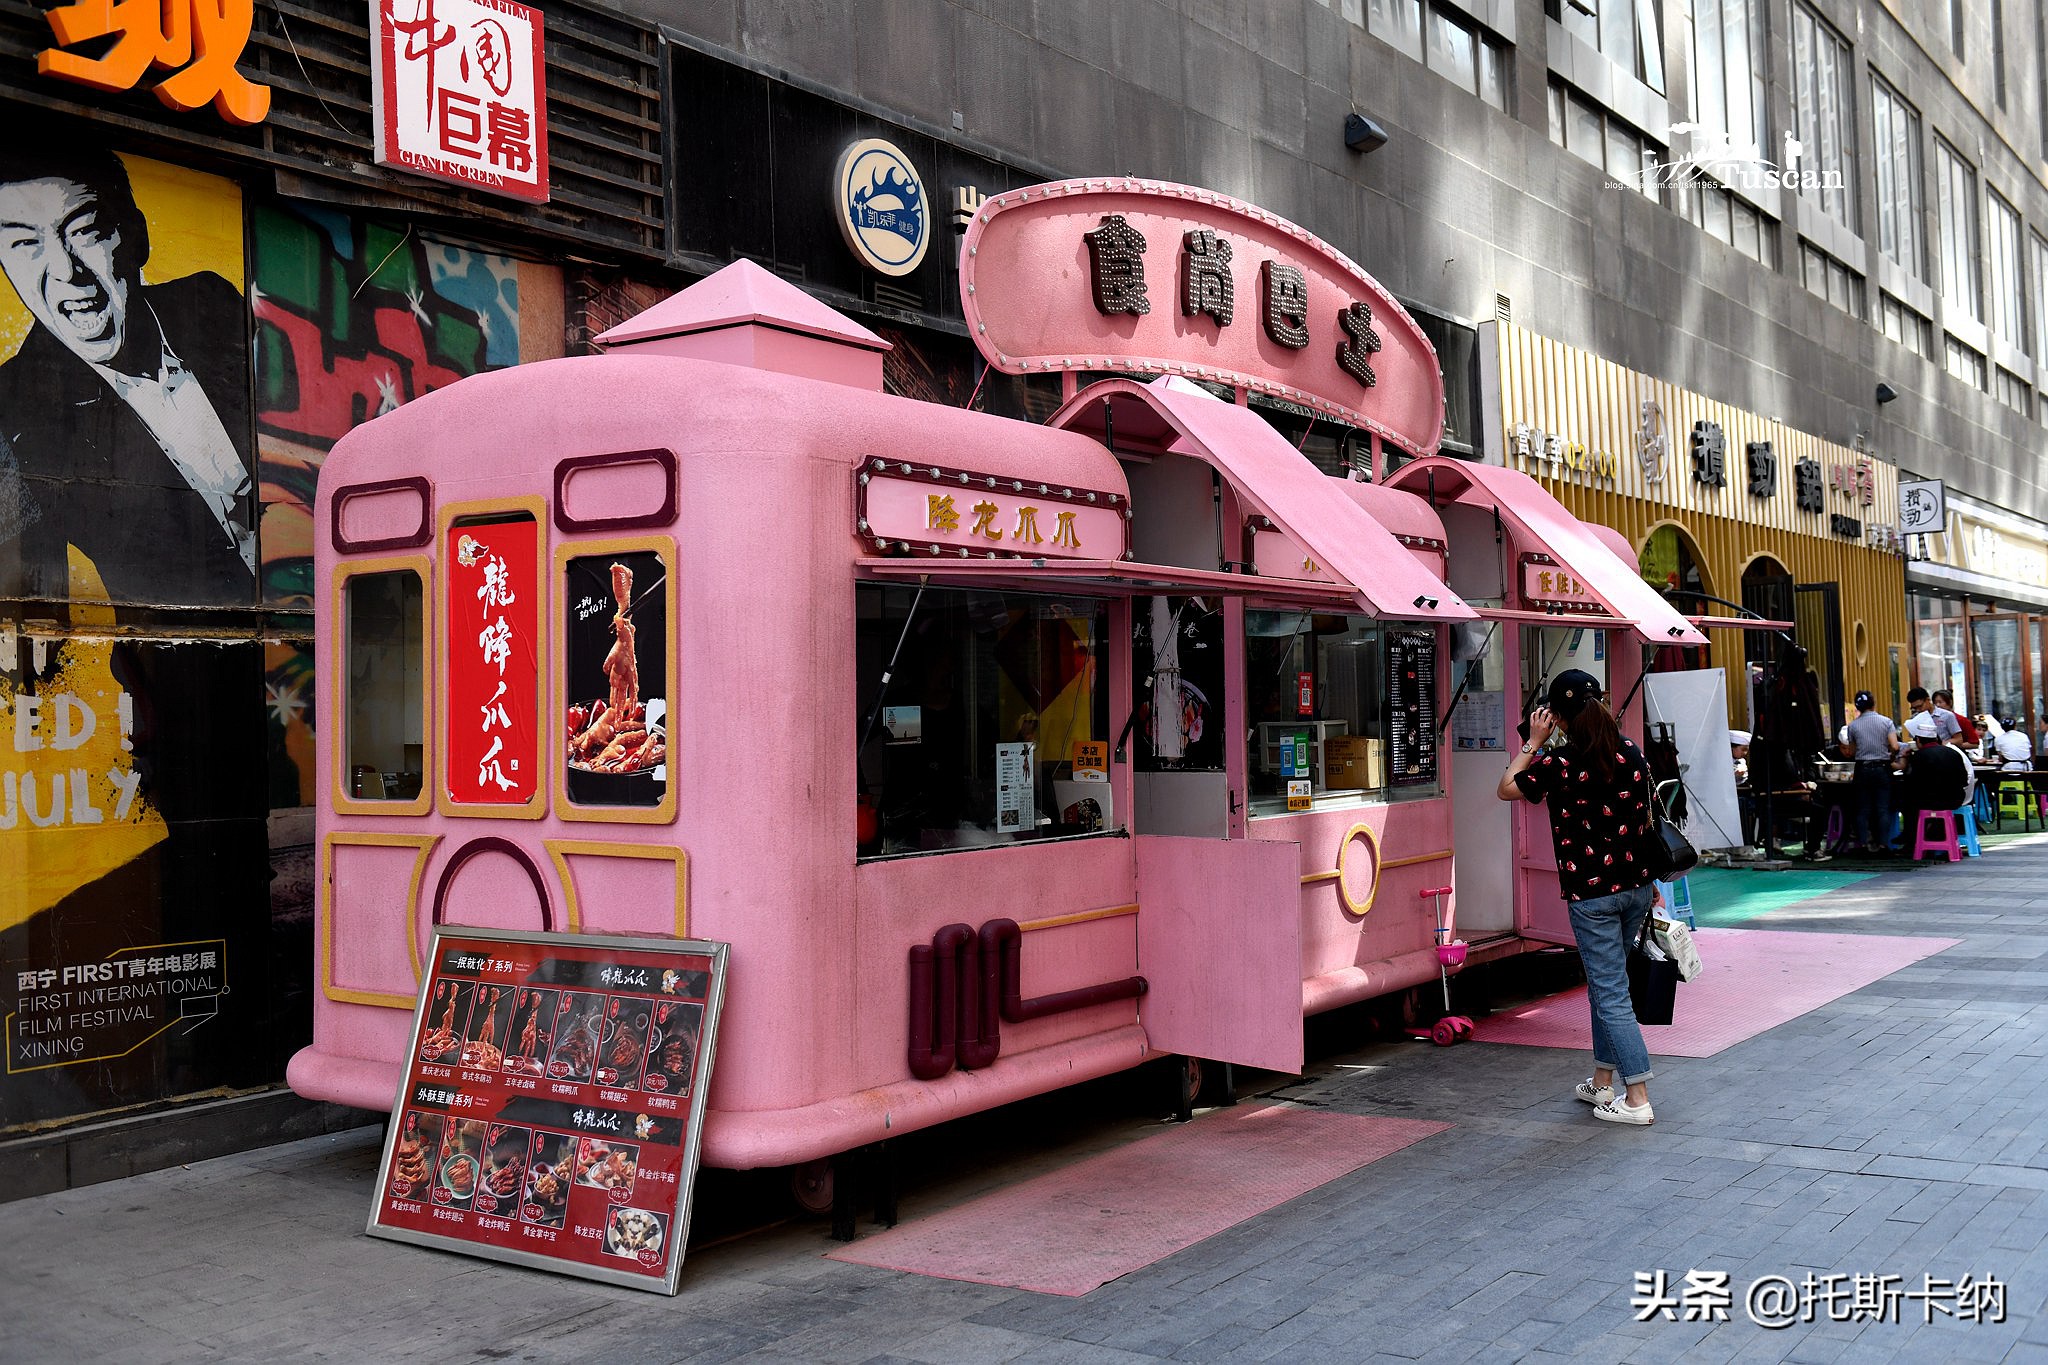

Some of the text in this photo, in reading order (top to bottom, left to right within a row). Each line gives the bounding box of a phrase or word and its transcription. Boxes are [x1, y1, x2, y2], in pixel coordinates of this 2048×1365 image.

[497, 0, 531, 22] FILM
[438, 88, 533, 173] 巨幕
[400, 150, 504, 187] GIANT SCREEN
[1084, 214, 1381, 388] 食尚巴士
[925, 494, 1082, 549] 降龙爪爪
[1077, 757, 1102, 767] 已加盟
[1082, 746, 1099, 756] 本店
[0, 767, 141, 830] JULY
[18, 969, 57, 992] 西宁
[18, 976, 217, 1013] FIRST INTERNATIONAL
[19, 1005, 155, 1037] FILM FESTIVAL
[20, 1036, 84, 1060] XINING
